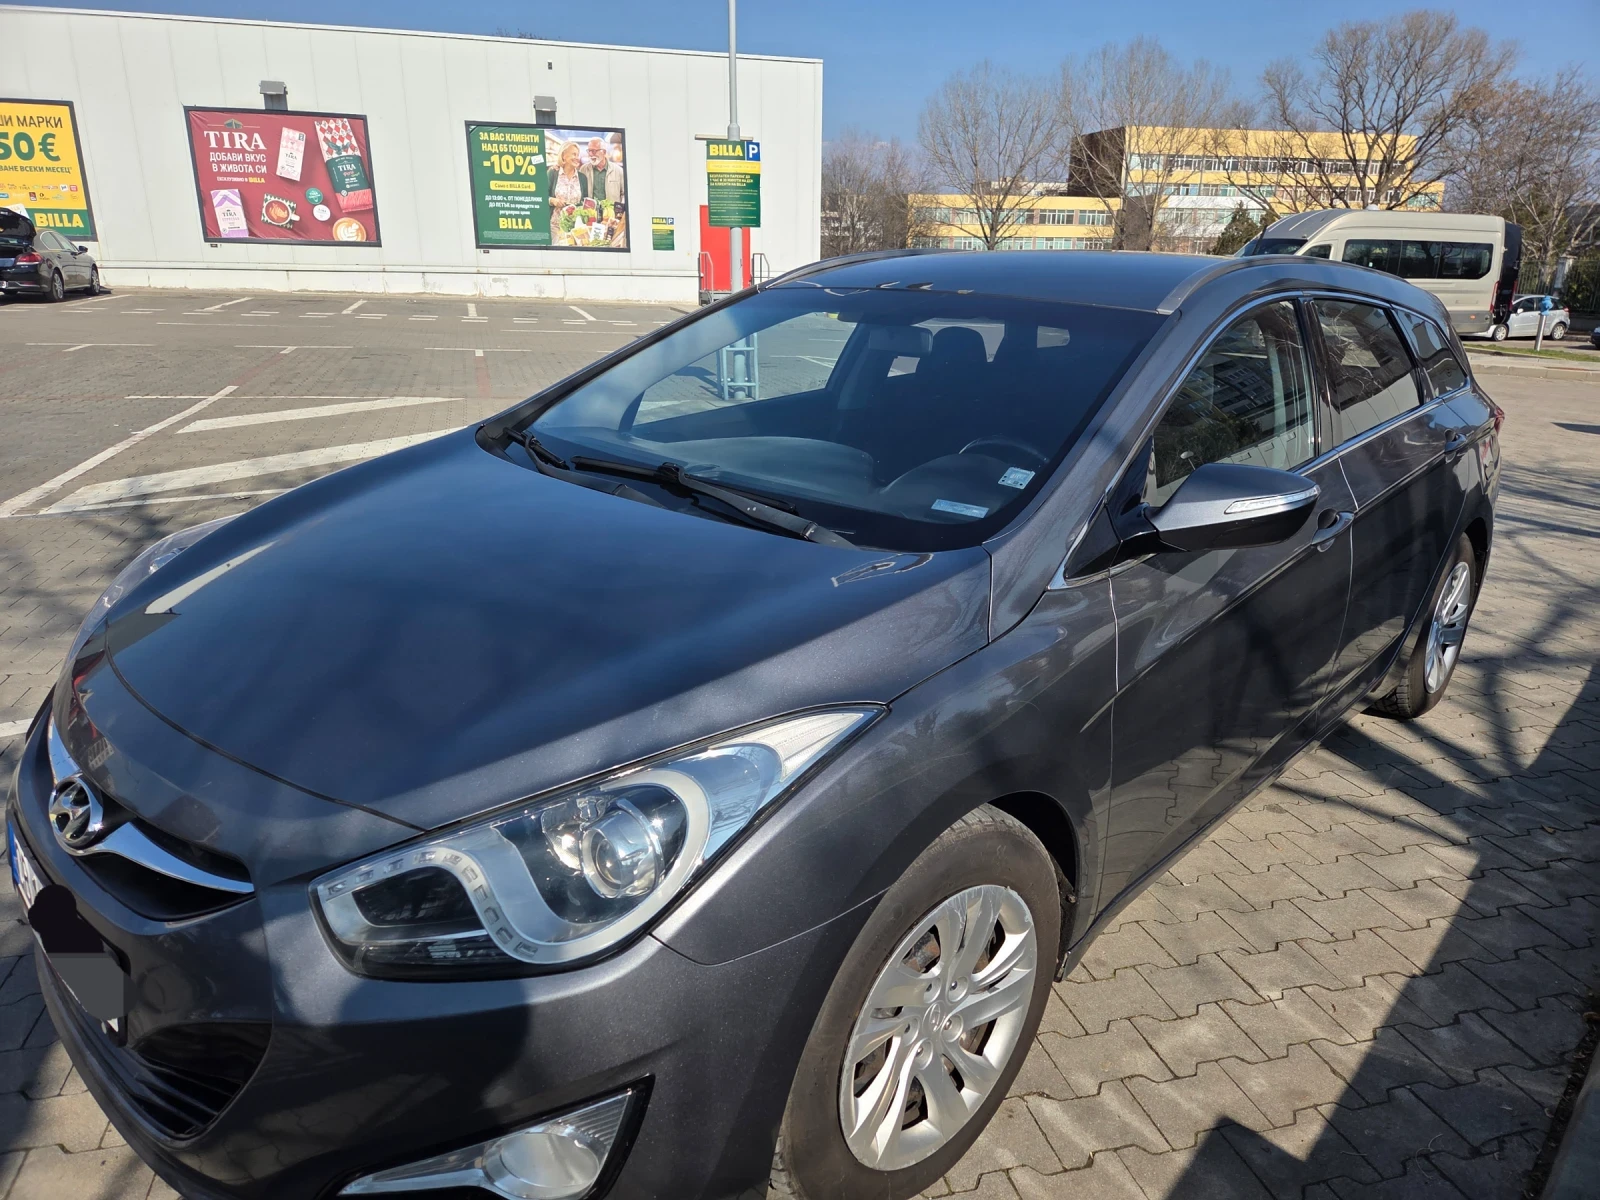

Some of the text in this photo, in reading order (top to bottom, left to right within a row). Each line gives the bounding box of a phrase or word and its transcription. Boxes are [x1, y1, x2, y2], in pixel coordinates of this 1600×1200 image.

[16, 115, 63, 128] МАРКИ
[204, 131, 267, 151] TIRA
[479, 132, 539, 143] ЗА ВАС КЛИЕНТИ
[0, 131, 61, 162] 50 €
[481, 143, 538, 154] НАД 65 ГОДИНИ
[709, 144, 758, 158] BILLA P
[210, 152, 266, 162] ДОБАВИ ВКУС
[20, 165, 44, 173] ВСЕКИ
[212, 163, 267, 173] В ЖИВОТА СИ
[337, 164, 356, 172] TIRA
[483, 154, 536, 175] -10%
[34, 213, 84, 228] BILLA
[499, 217, 532, 229] BILLA
